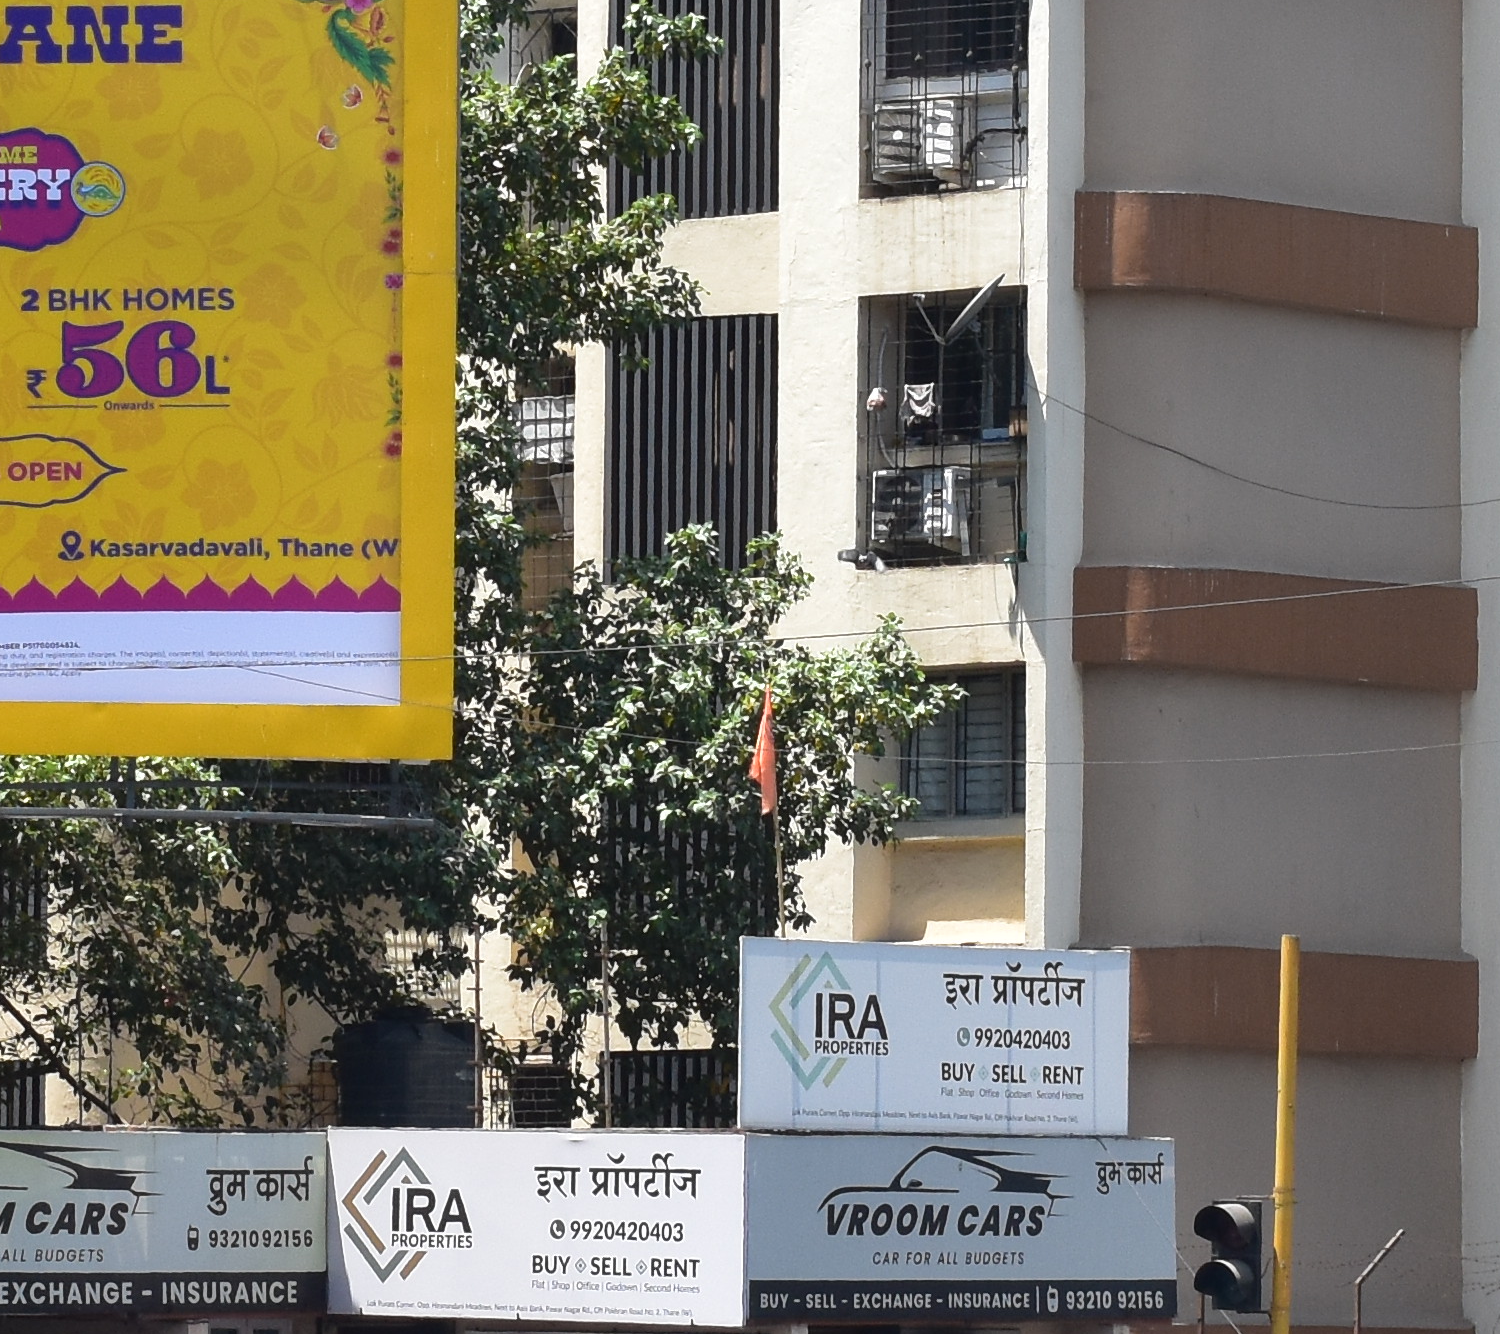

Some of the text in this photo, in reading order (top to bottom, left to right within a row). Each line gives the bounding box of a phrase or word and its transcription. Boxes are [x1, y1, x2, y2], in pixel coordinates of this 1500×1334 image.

[20, 287, 236, 312] 2 BHK HOMES
[103, 400, 155, 412] Onwards
[6, 460, 84, 482] OPEN
[90, 538, 271, 561] Kasarvadavali,
[278, 538, 354, 557] Thane
[942, 961, 1086, 1009] इरा प्रॉपर्टीज
[814, 991, 889, 1041] IRA
[814, 1039, 890, 1056] PROPERTIES
[974, 1027, 1071, 1050] 9920420403
[940, 1062, 1085, 1086] BUY SELL RENT
[533, 1152, 702, 1204] इरा प्रॉपर्टीज
[24, 1201, 130, 1236] CARS
[391, 1186, 473, 1234] IRA
[825, 1203, 1046, 1237] VROOM CARS
[391, 1233, 473, 1250] PROPERTIES
[569, 1220, 685, 1243] 9920420403
[0, 1247, 28, 1264] ALL
[34, 1247, 105, 1264] BUDGETS
[531, 1254, 701, 1279] BUY SELL RENT
[872, 1251, 1025, 1265] CAR FOR ALL BUDGETS
[161, 1279, 300, 1305] INSURANCE
[759, 1291, 1165, 1310] BUY SELL EXCHANGE INSURANCE 93210 92156
